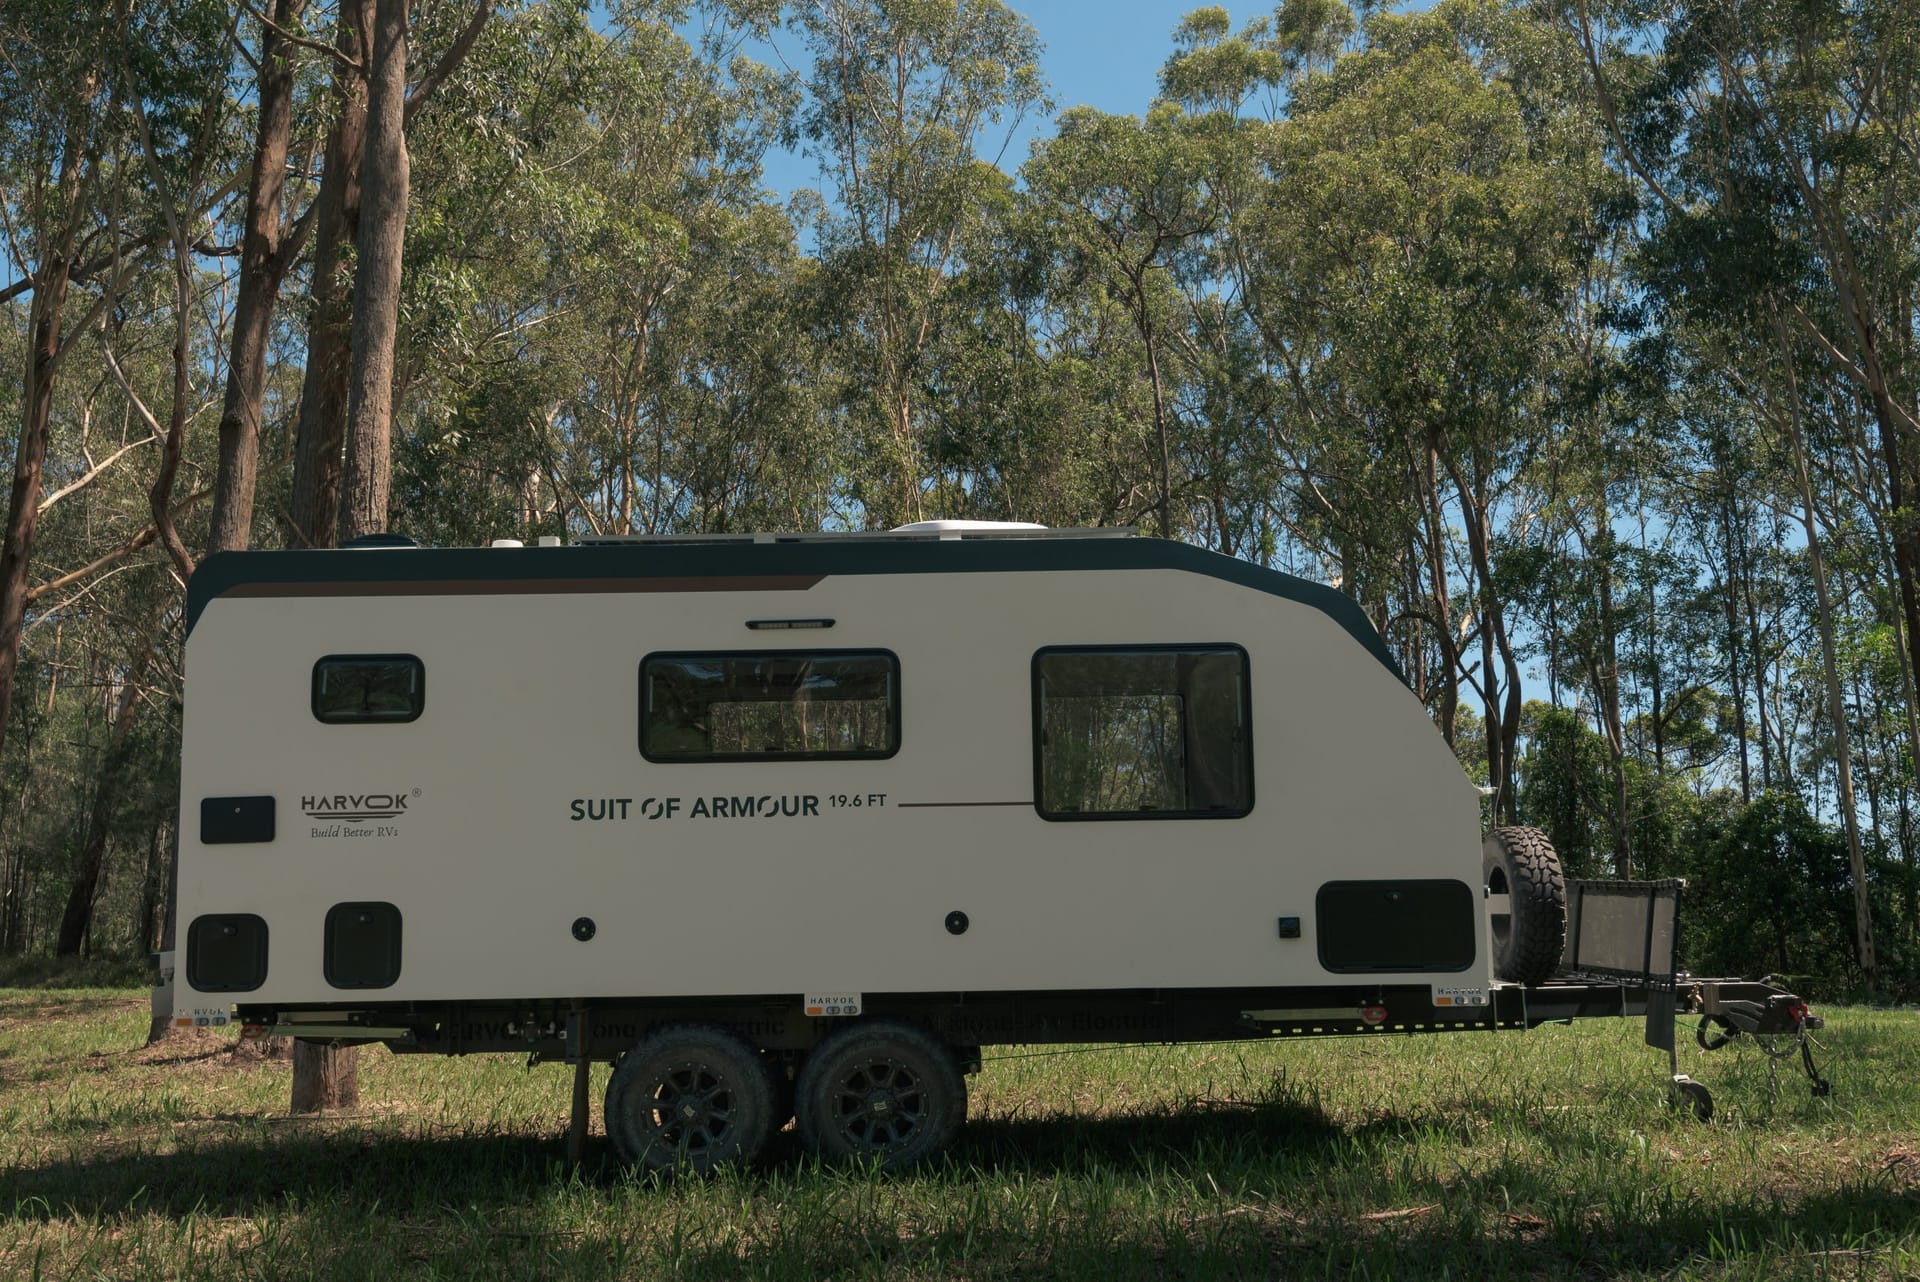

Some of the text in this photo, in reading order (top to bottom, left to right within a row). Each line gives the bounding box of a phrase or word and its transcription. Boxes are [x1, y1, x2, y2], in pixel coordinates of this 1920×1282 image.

[301, 793, 408, 810] HARVOK
[570, 793, 887, 821] SUIT OF ARMOUR 19.6 FT
[311, 825, 398, 839] Build Better RVs
